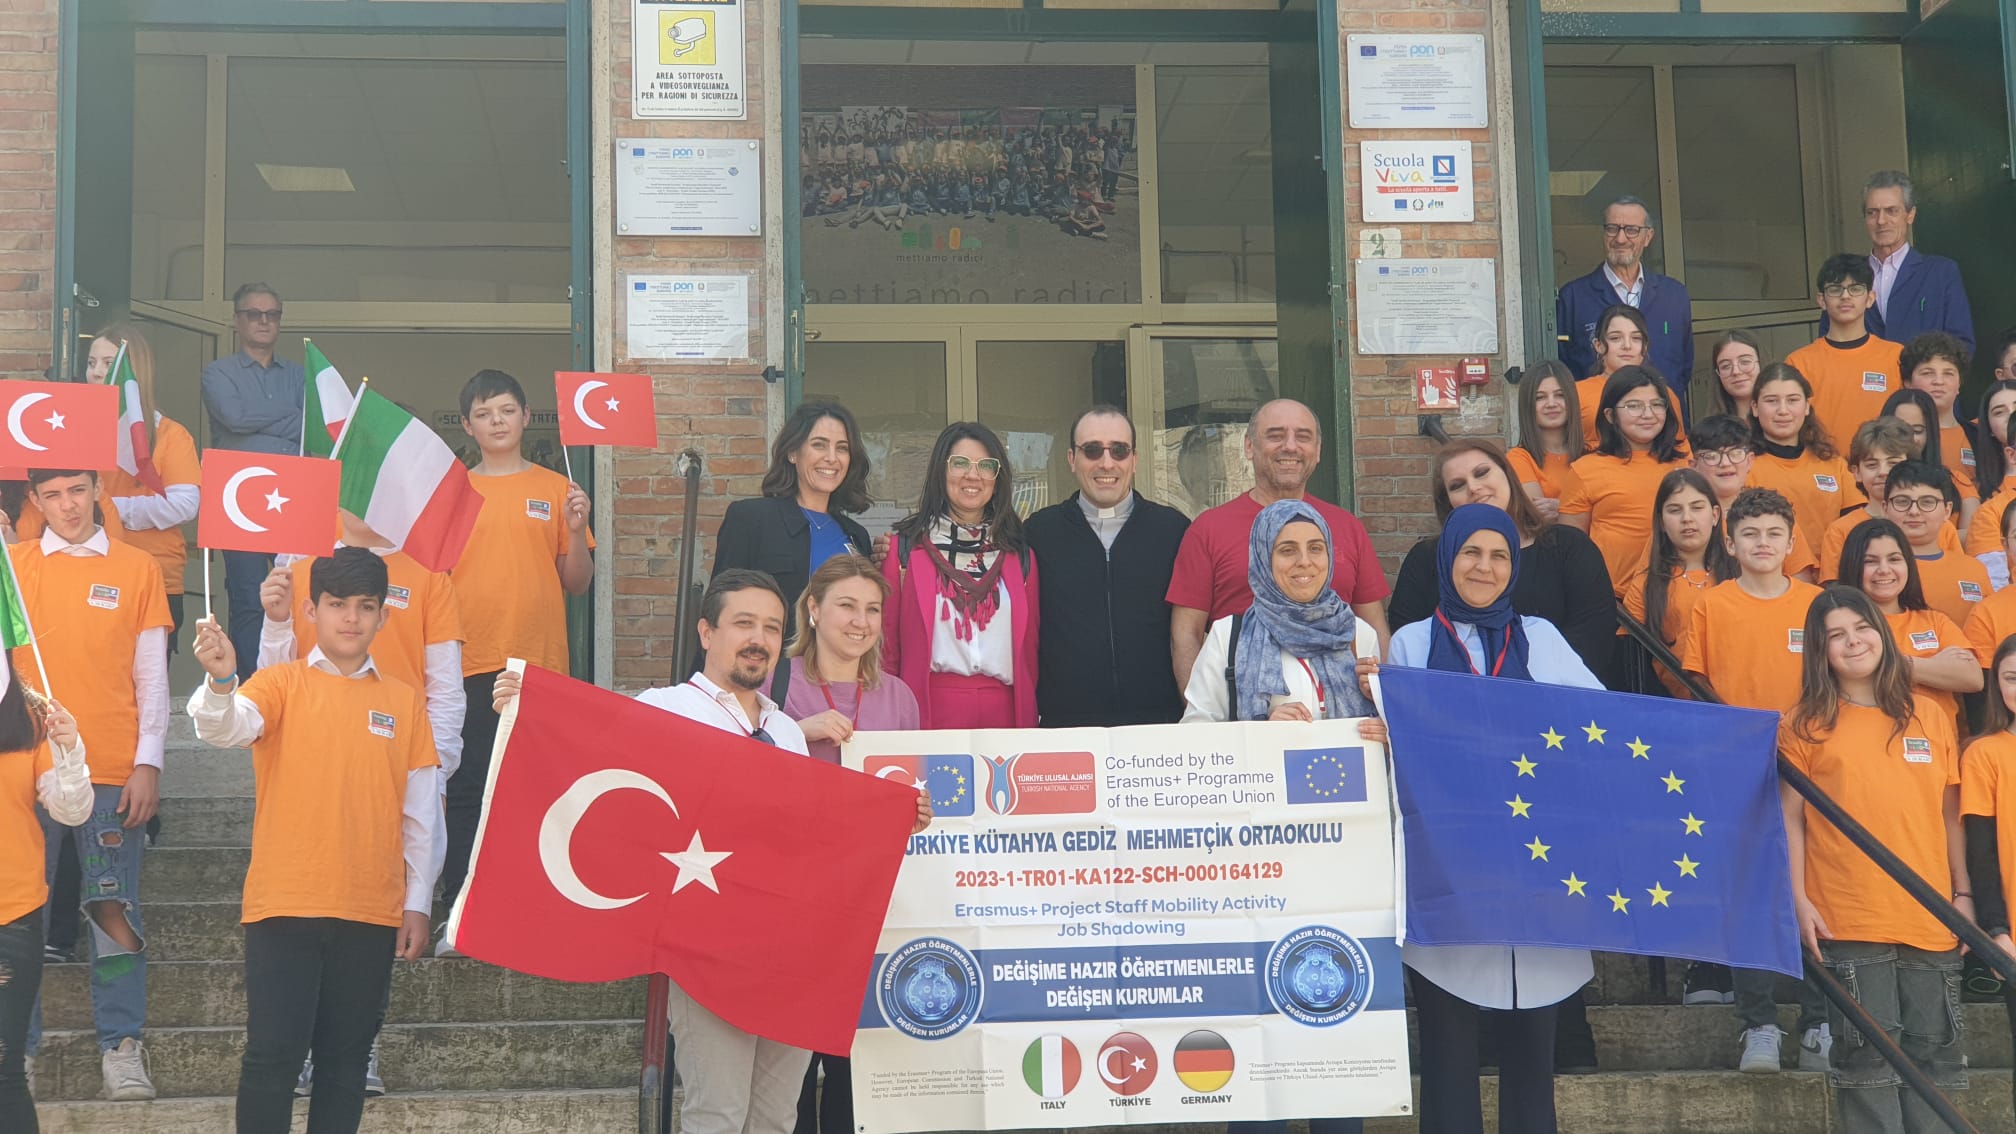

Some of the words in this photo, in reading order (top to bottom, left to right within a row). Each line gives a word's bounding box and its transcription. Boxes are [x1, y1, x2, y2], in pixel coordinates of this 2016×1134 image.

[678, 72, 724, 80] SOTTOPOSTA
[1374, 153, 1424, 167] Scuola
[1370, 233, 1386, 256] 2
[896, 254, 948, 262] mettiamo
[952, 253, 983, 262] radici
[1014, 280, 1128, 304] radici
[1106, 754, 1183, 770] Co-funded
[1188, 753, 1206, 769] by
[1211, 752, 1234, 766] the
[1018, 773, 1043, 782] TÜRKİYE
[1045, 774, 1070, 782] ULUSAL
[1107, 774, 1182, 789] Erasmus+
[1187, 772, 1274, 789] Programme
[1108, 794, 1122, 808] of
[1125, 793, 1148, 807] the
[1152, 791, 1227, 808] European
[1233, 790, 1275, 804] Union
[905, 830, 970, 855] RKİYE
[974, 828, 1057, 854] KÜTAHYA
[1062, 826, 1116, 851] GEDİZ
[1127, 822, 1233, 854] MEHMETÇİK
[1239, 822, 1343, 846] ORTAOKULU
[955, 861, 1283, 887] 2023-1-TR01-KA122-SCH-000164129
[955, 904, 1038, 917] Erasmus+
[1042, 901, 1101, 918] Project
[1105, 899, 1148, 914] Staff
[1152, 896, 1218, 914] Mobility
[1222, 894, 1286, 911] Activity
[1058, 922, 1087, 937] Job
[1091, 920, 1186, 937] Shadowing
[1272, 943, 1291, 977] DEĞİŞİME
[1290, 930, 1313, 944] HAZIR
[1314, 928, 1365, 974] ÖĞRETMENLERLE
[885, 954, 904, 990] DEĞİŞİME
[904, 942, 927, 956] HAZIR
[928, 940, 976, 986] ÖĞRETMENLERLE
[993, 960, 1066, 986] DEĞİŞİME
[1070, 962, 1117, 980] HAZIR
[1121, 956, 1255, 978] ÖĞRETMENLERLE
[1047, 988, 1112, 1012] DEĞİŞEN
[1116, 986, 1203, 1005] KURUMLAR
[1285, 1004, 1316, 1023] DEĞİŞEN
[1318, 1002, 1357, 1023] KURUMLAR
[896, 1016, 927, 1036] DEĞİŞEN
[928, 1014, 968, 1036] KURUMLAR
[1040, 1101, 1066, 1110] ITALY
[1110, 1097, 1152, 1107] TÜRKİYE
[1181, 1095, 1232, 1105] GERMANY
